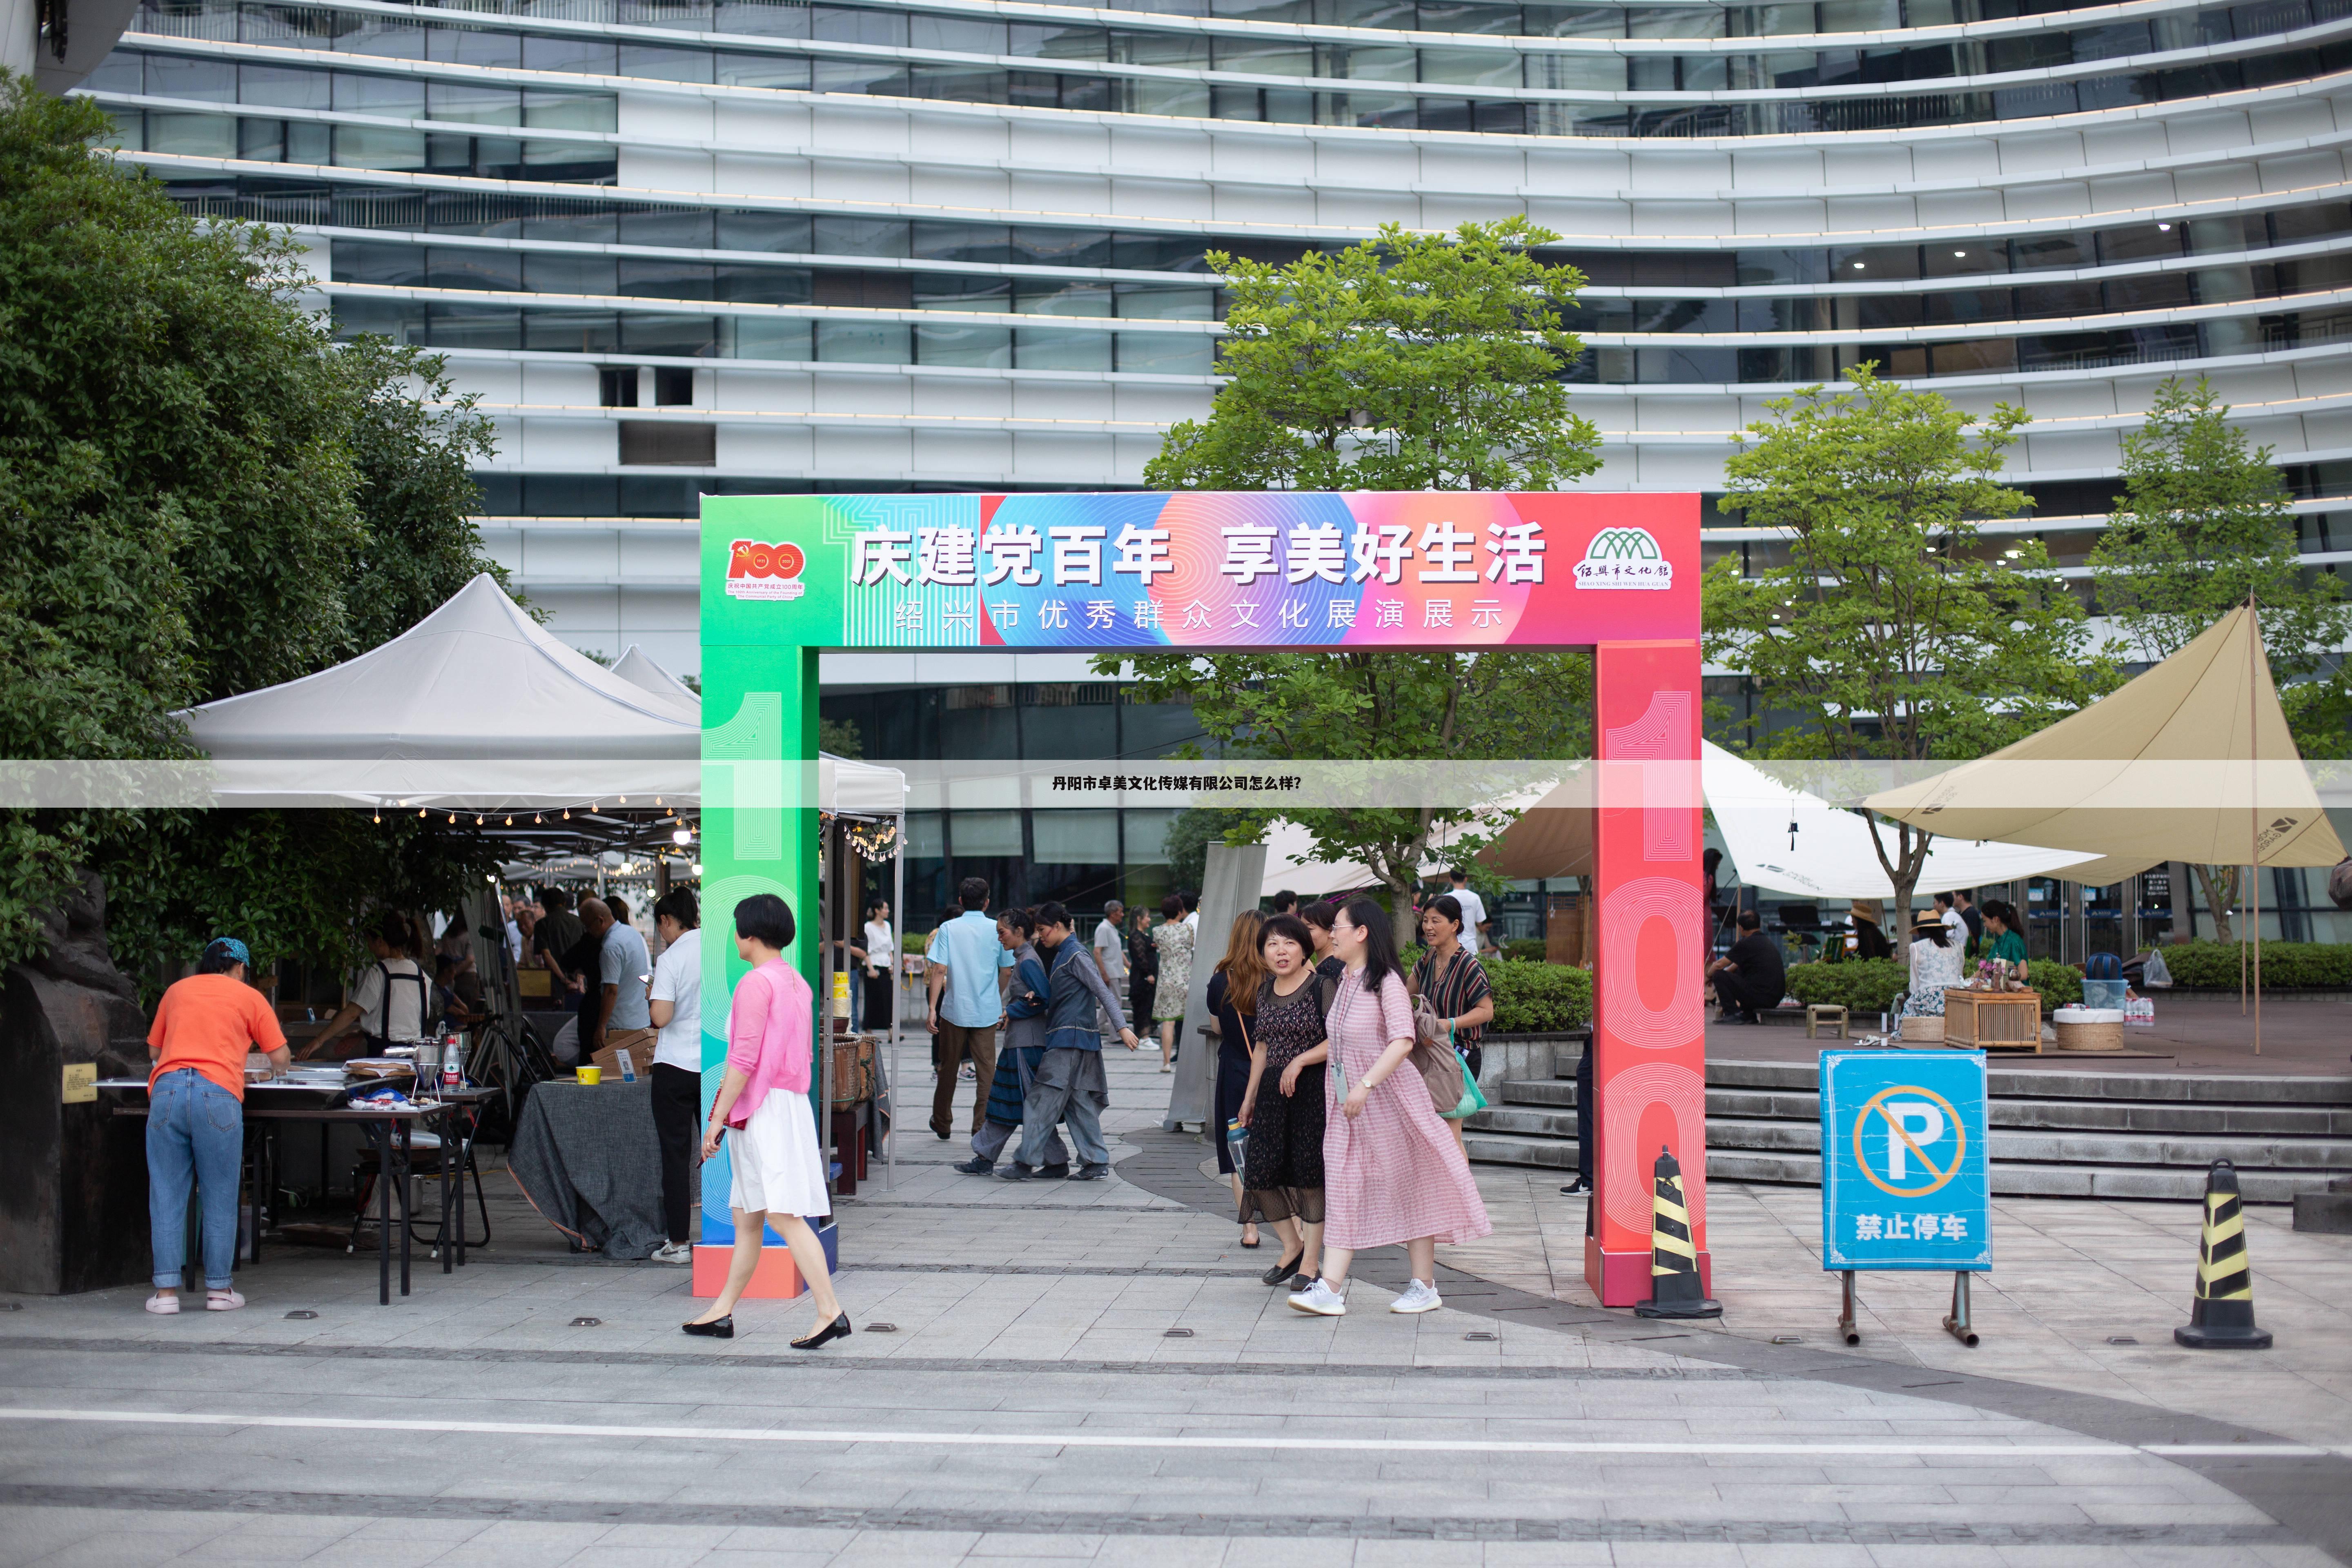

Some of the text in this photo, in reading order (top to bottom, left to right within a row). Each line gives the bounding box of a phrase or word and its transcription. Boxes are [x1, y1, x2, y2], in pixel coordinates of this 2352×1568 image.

[728, 541, 804, 579] 100
[850, 521, 1546, 586] 庆建党百年 享美好生活
[896, 599, 1503, 630] 绍兴市优秀群众文化展演展示
[1855, 1214, 1968, 1241] 禁止停车
